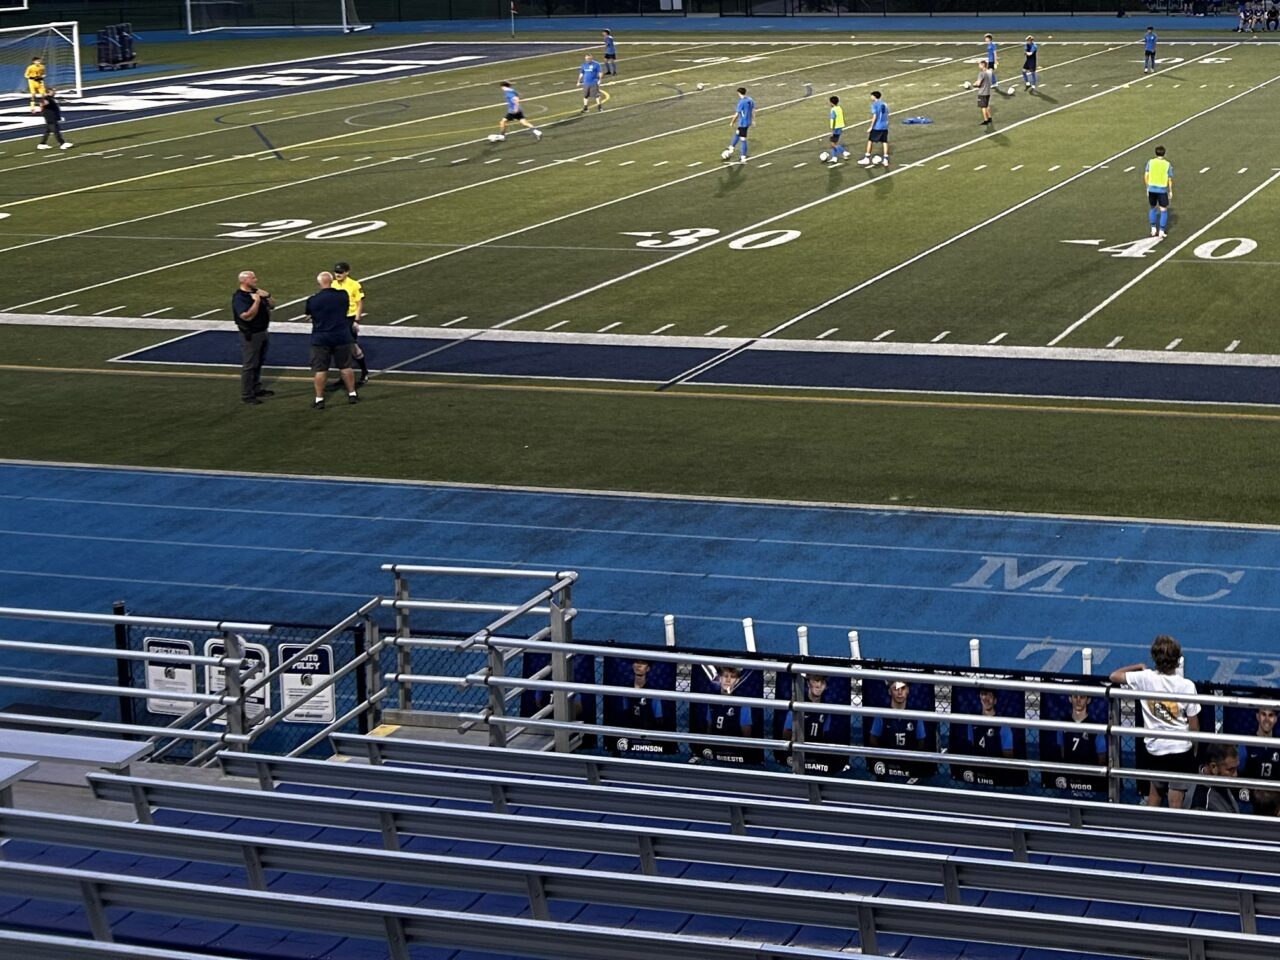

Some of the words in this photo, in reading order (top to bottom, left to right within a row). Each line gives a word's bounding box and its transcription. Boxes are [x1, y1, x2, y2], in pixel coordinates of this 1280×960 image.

[292, 661, 321, 670] POLICY
[717, 716, 725, 730] 9
[810, 722, 820, 737] 11
[895, 732, 906, 747] 15
[978, 736, 987, 749] 4
[1071, 737, 1080, 752] 7
[631, 744, 664, 753] JOHNSON
[1260, 762, 1272, 778] 13
